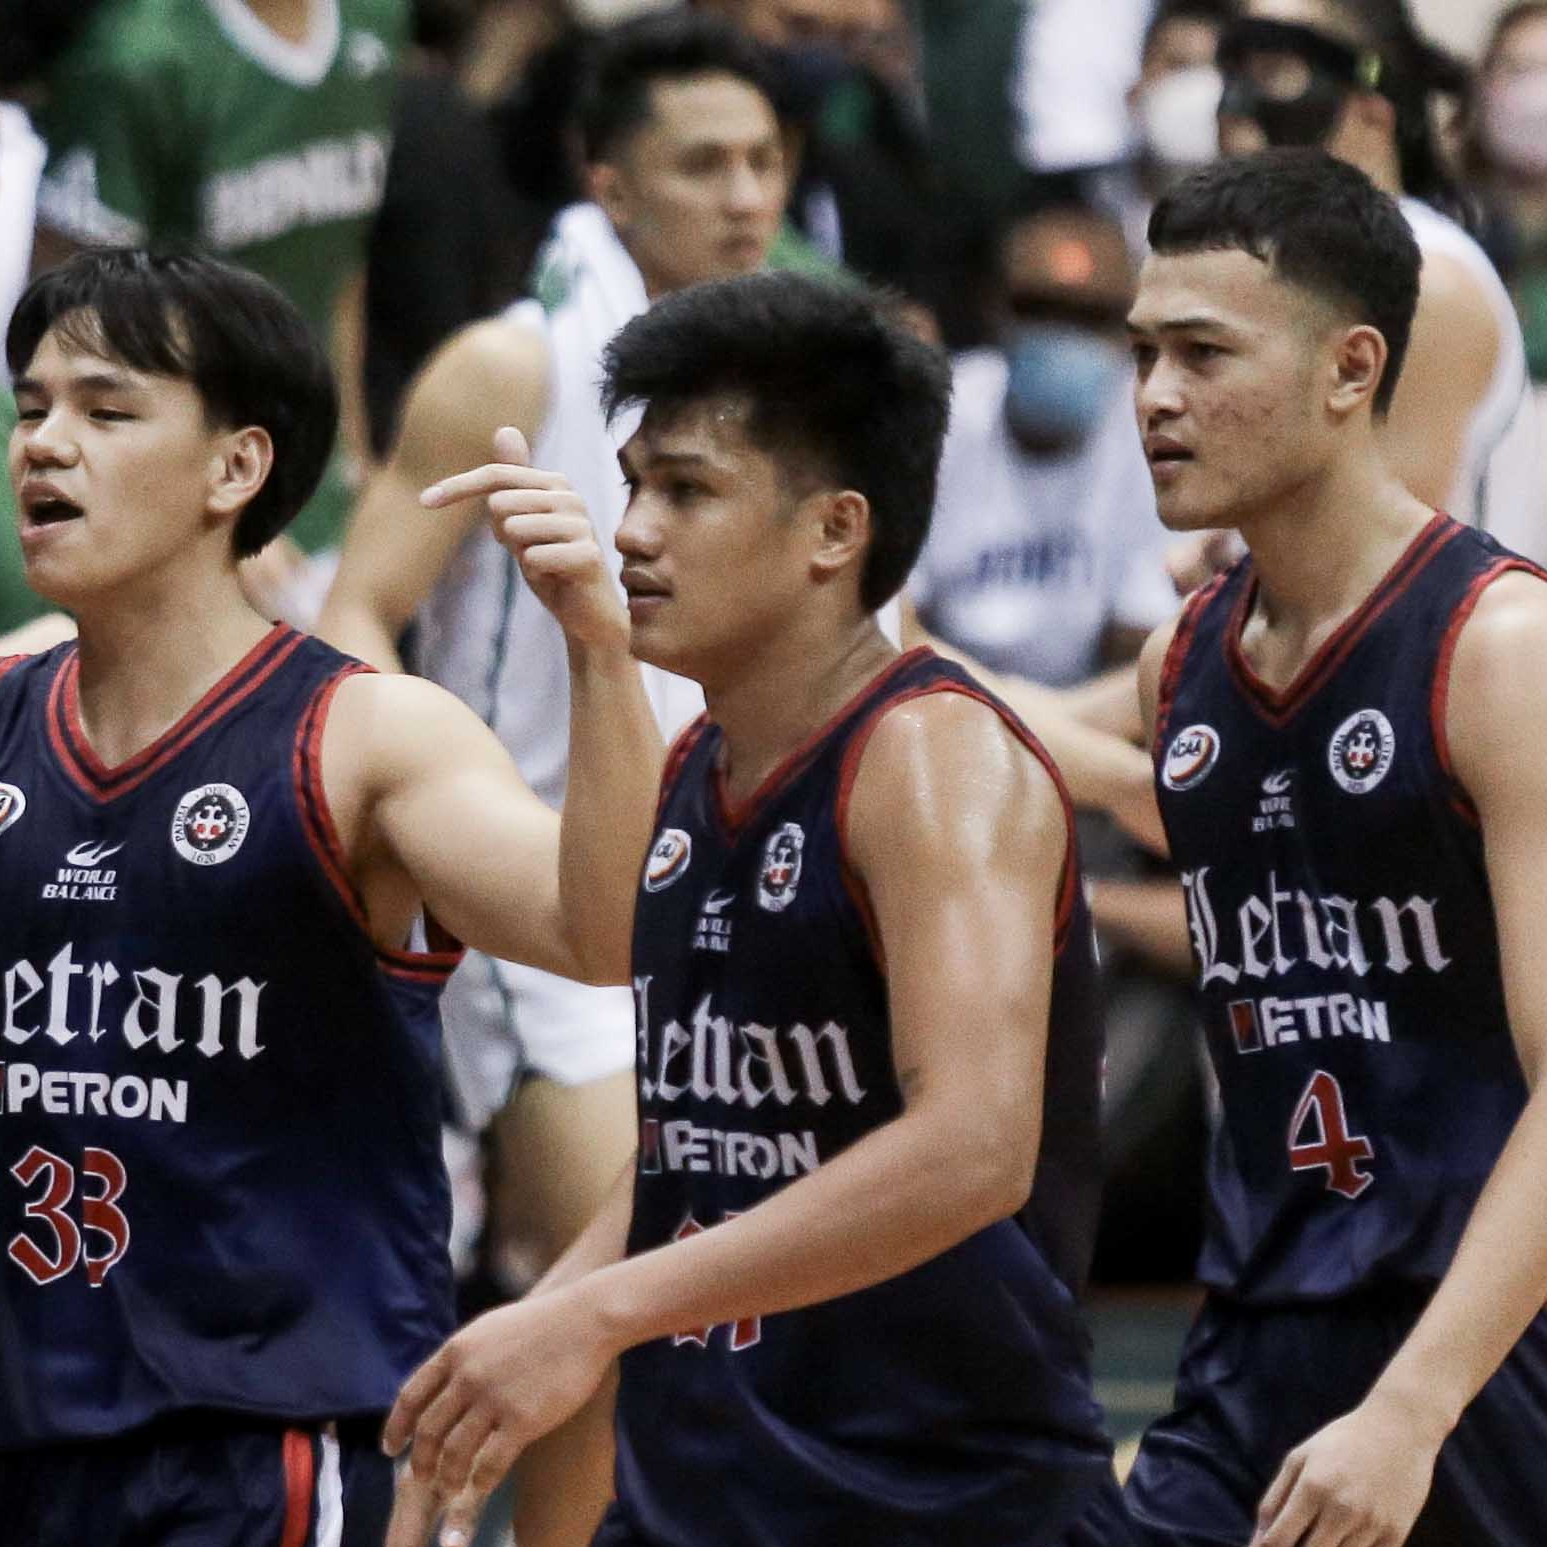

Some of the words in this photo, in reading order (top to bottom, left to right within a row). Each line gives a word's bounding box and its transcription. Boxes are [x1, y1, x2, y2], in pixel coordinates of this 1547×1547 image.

[42, 884, 118, 901] BALANCE
[57, 868, 117, 884] WORLD
[6, 1062, 189, 1123] PETRON
[1288, 1069, 1375, 1200] 4
